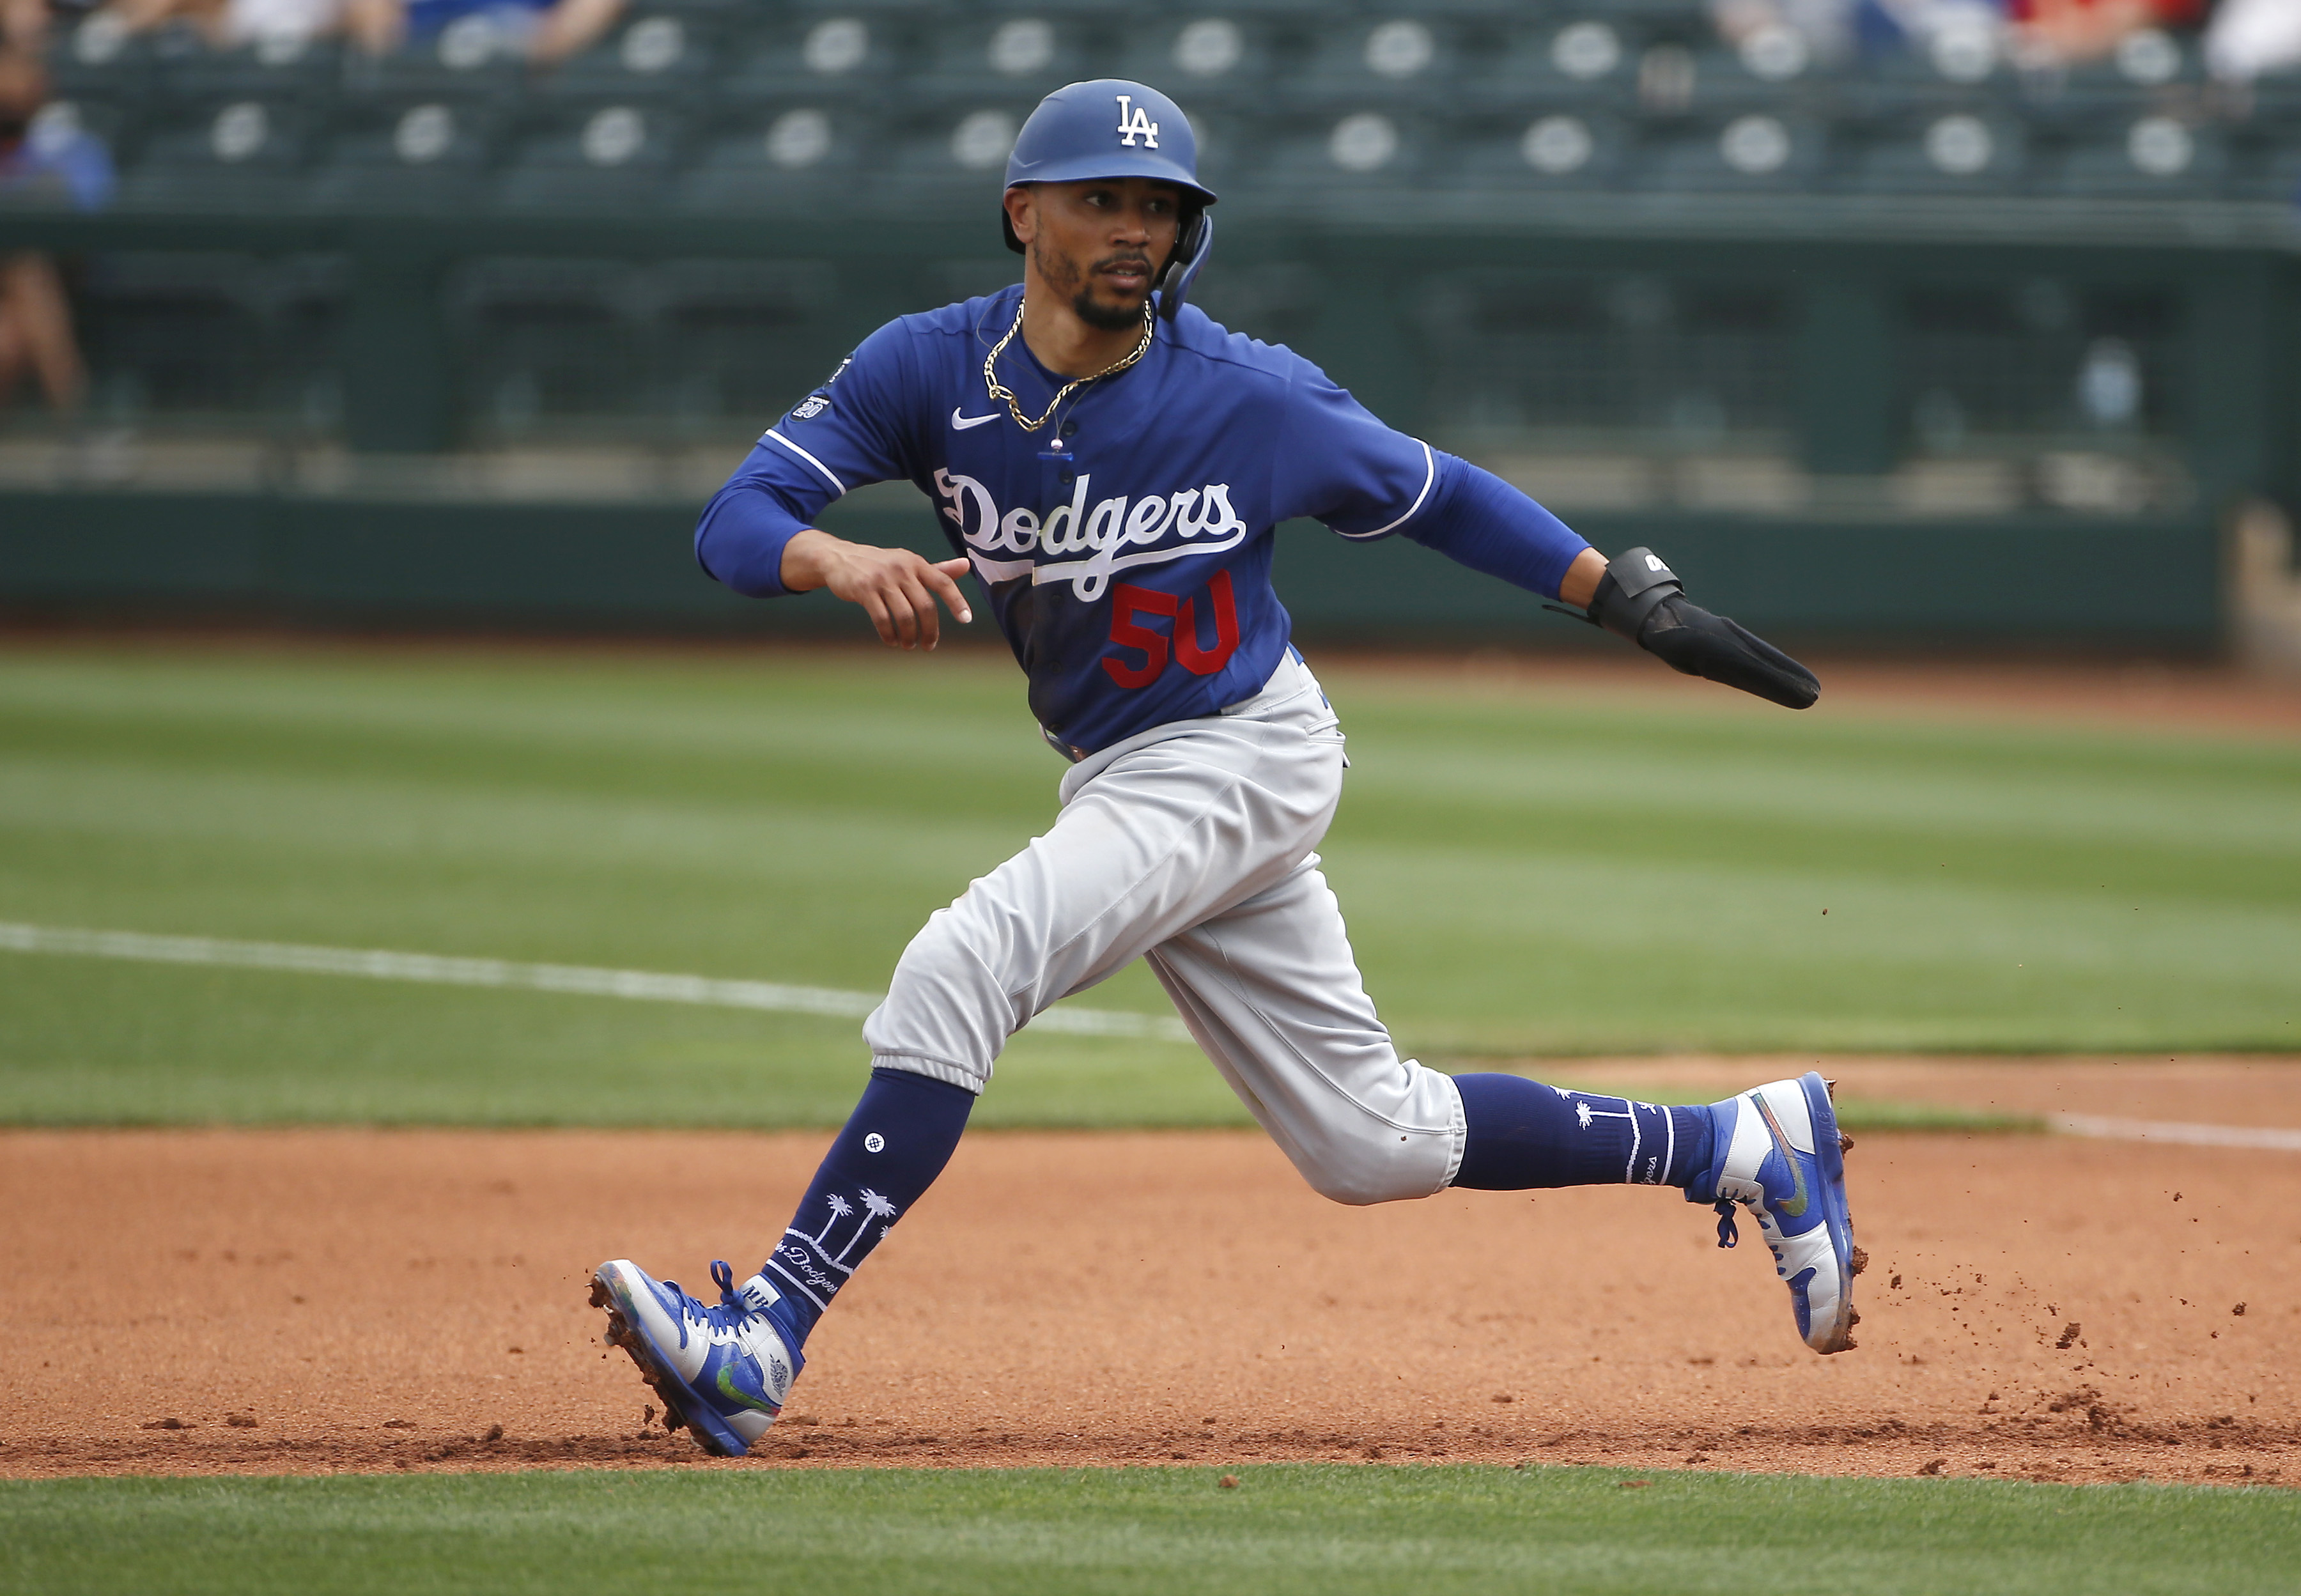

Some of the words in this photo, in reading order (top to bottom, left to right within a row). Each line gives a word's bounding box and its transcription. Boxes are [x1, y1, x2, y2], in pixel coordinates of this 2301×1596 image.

[1116, 95, 1159, 149] LA
[793, 401, 824, 419] 20
[934, 467, 1247, 603] Dodgers
[1101, 568, 1240, 688] 50
